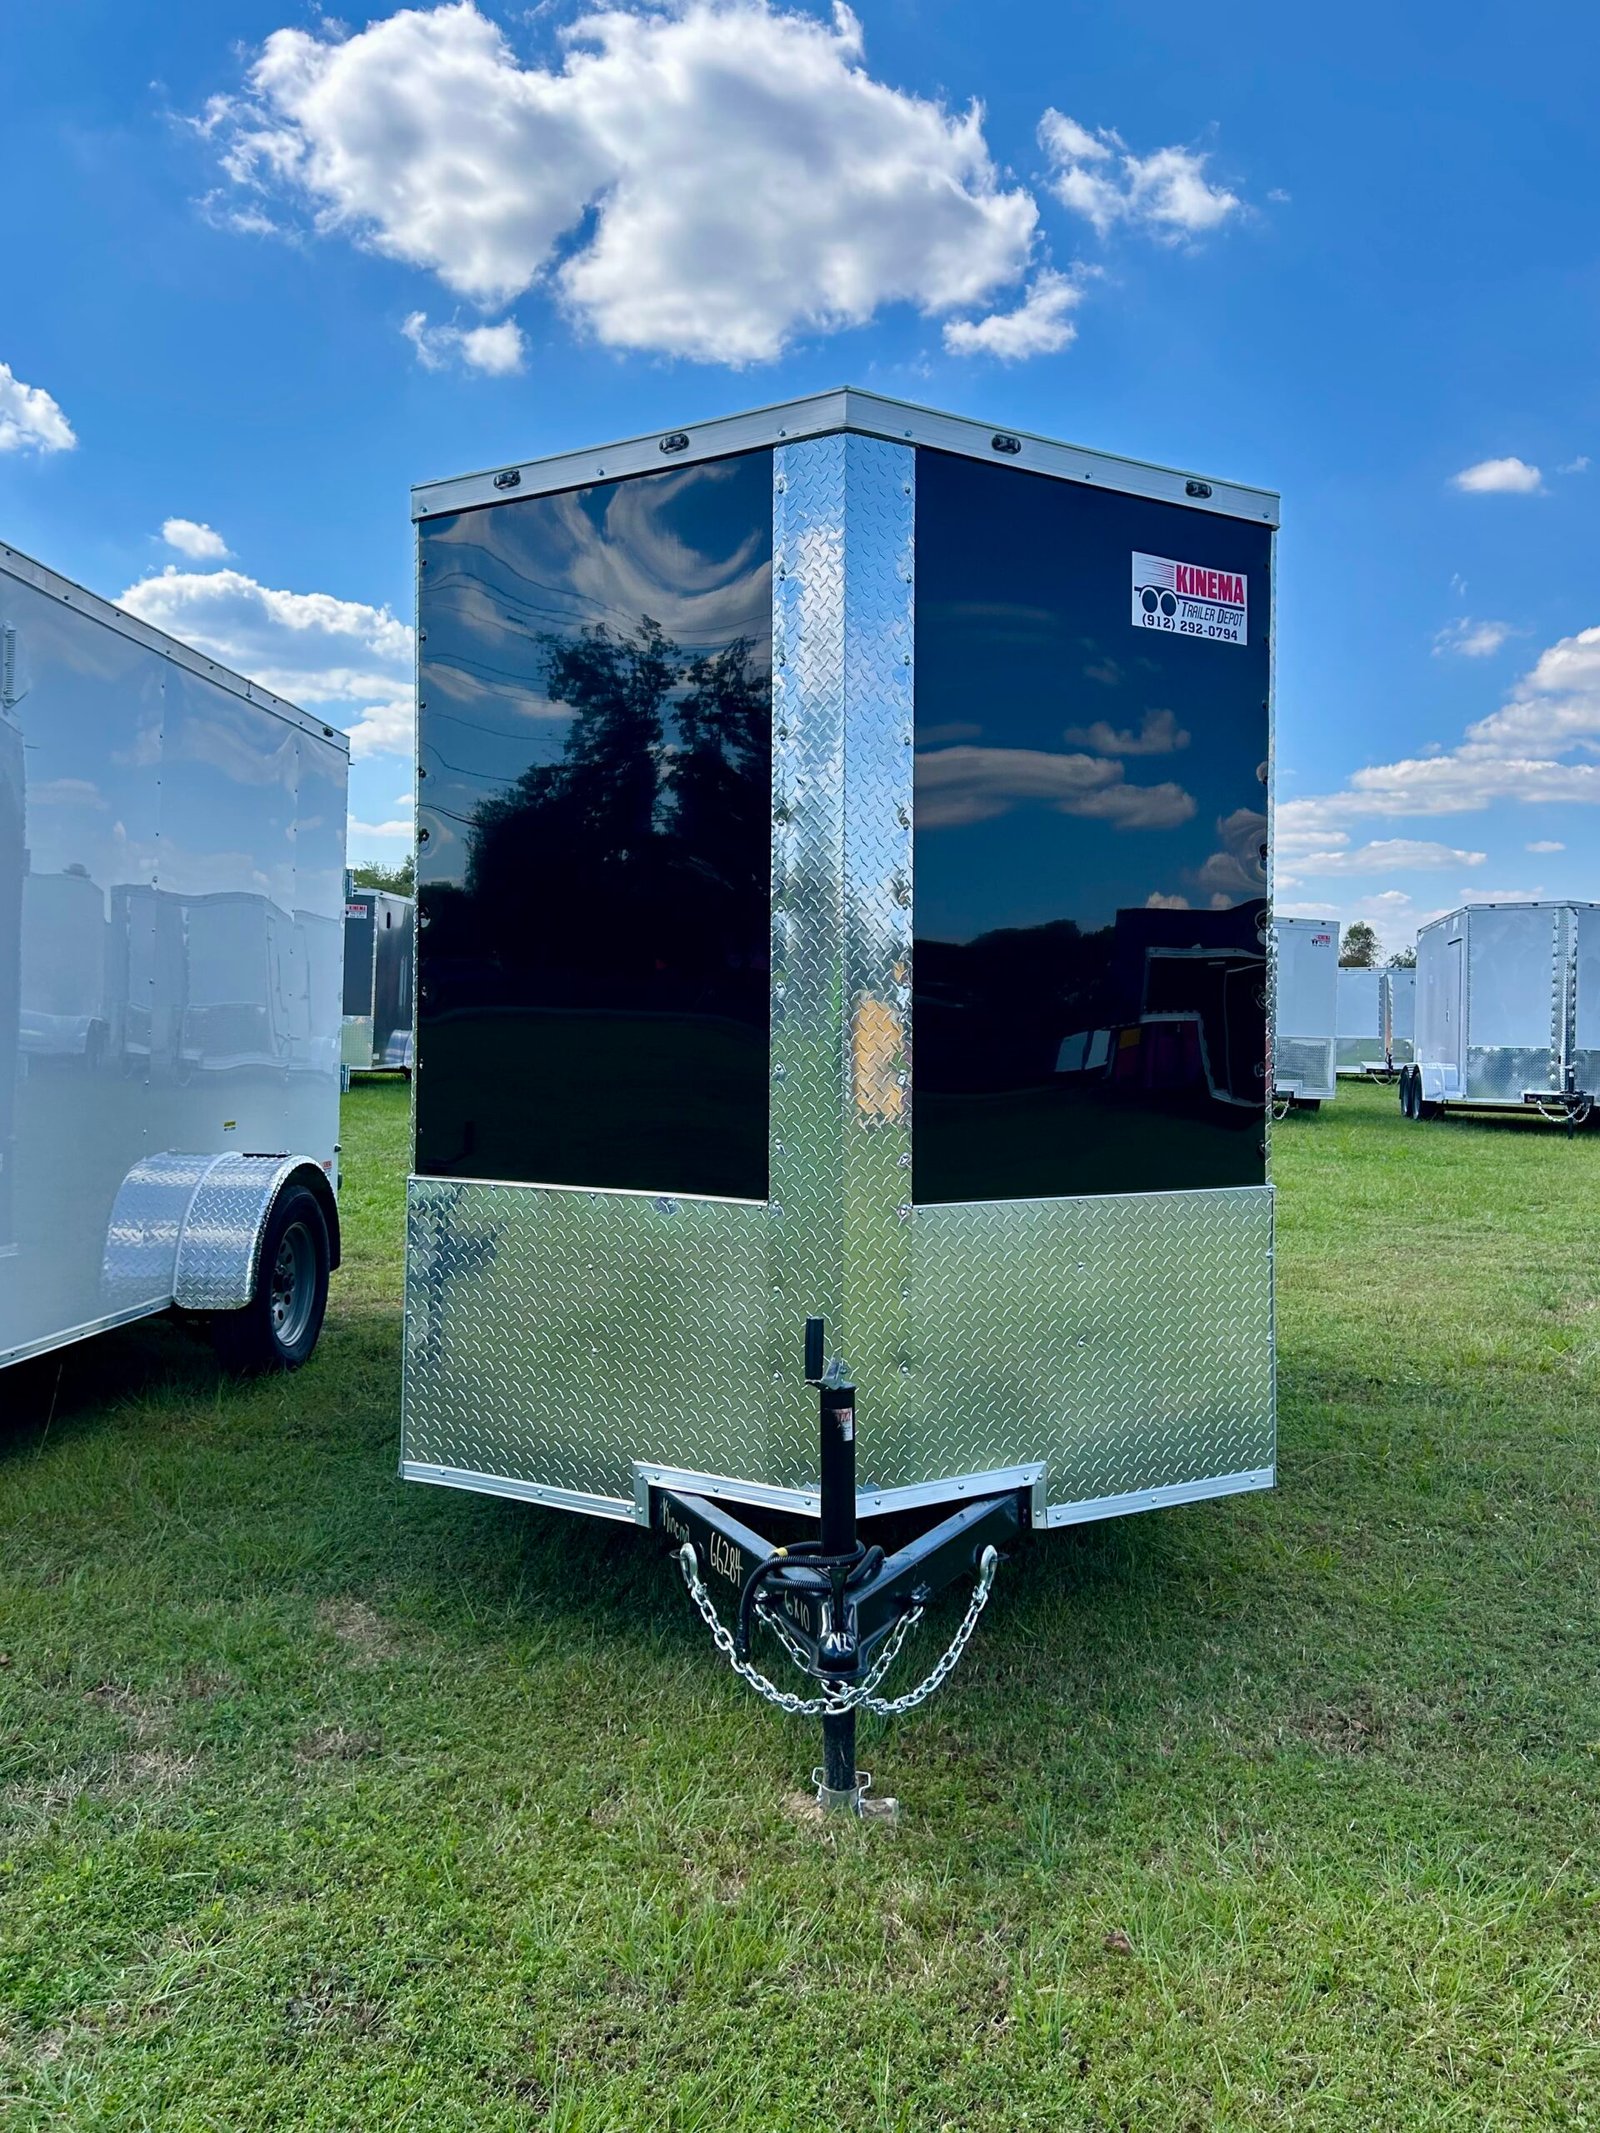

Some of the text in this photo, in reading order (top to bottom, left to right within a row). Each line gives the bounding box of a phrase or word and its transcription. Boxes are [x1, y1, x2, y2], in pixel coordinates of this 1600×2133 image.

[1176, 564, 1245, 605] KINEMA
[1142, 613, 1238, 641] (912) 292-0794
[1181, 601, 1244, 627] TRAILER DEPOT
[710, 1531, 744, 1588] 66284
